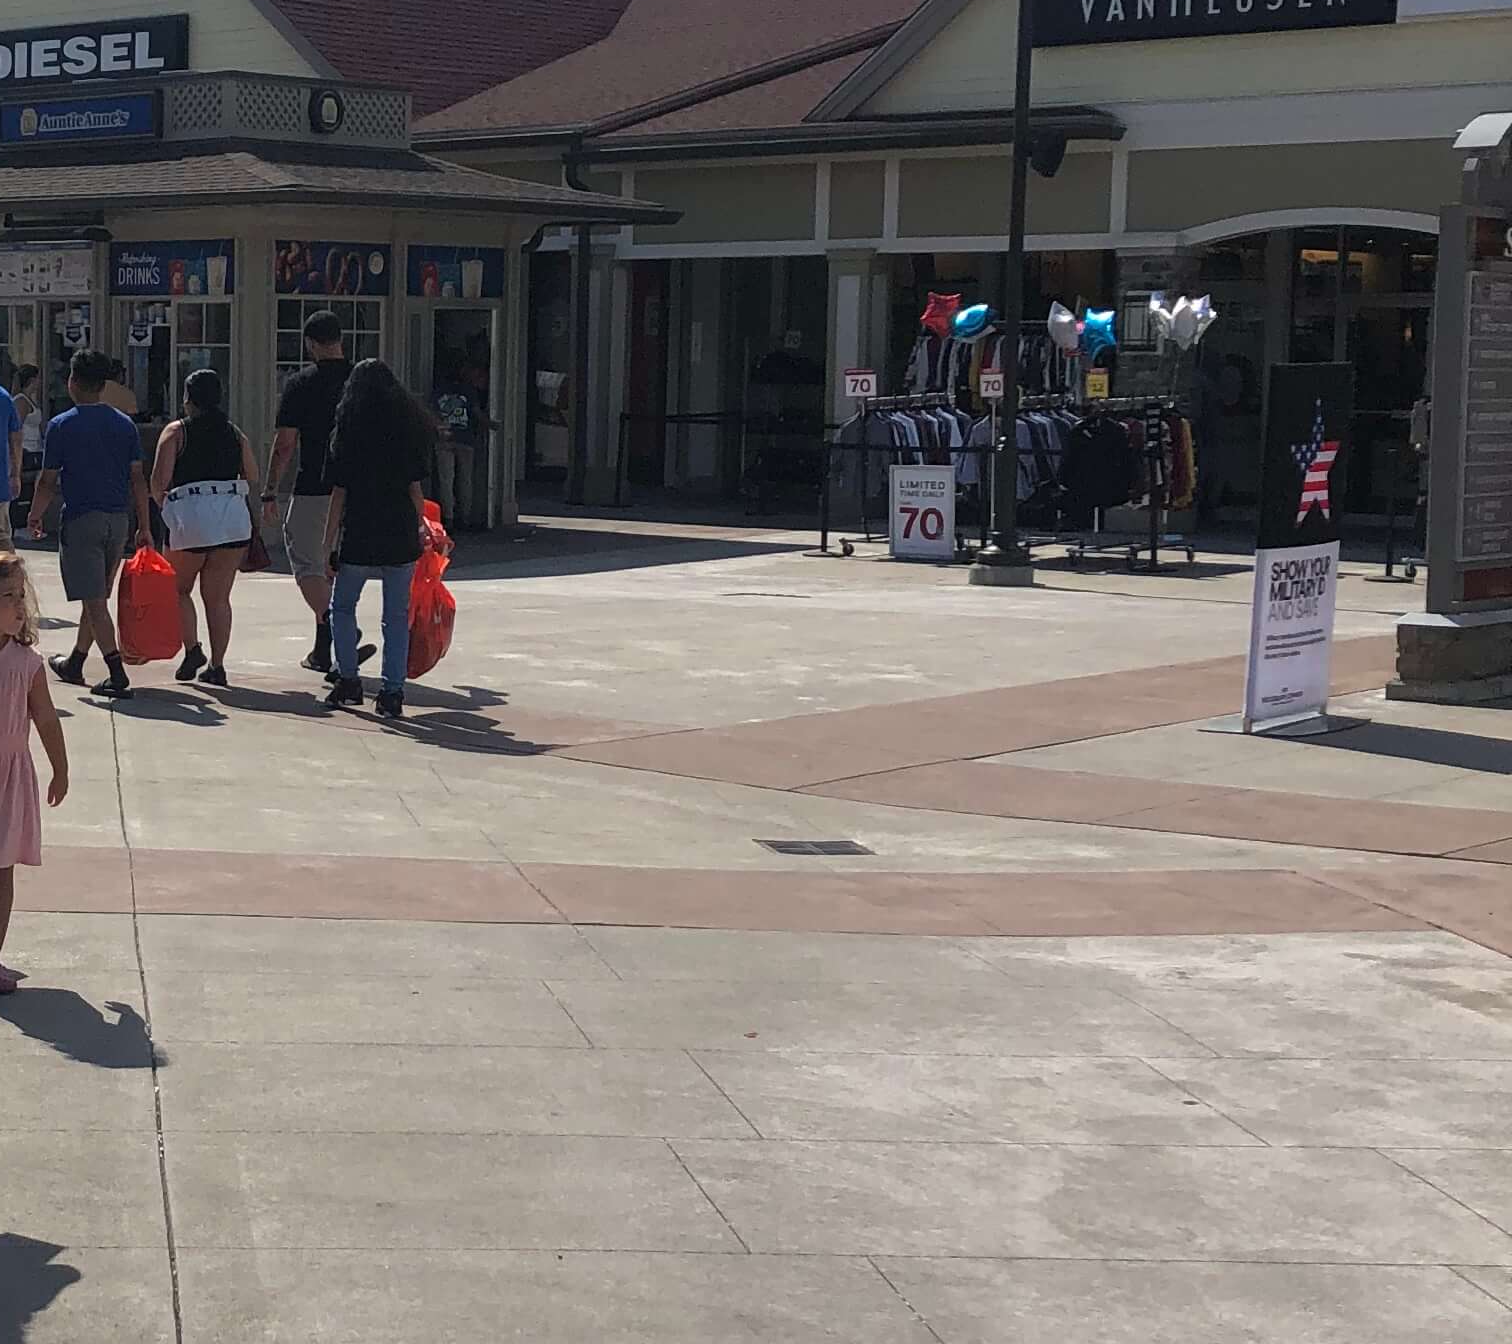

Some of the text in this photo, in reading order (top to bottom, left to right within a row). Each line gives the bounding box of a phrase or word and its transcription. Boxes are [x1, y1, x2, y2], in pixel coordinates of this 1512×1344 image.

[118, 267, 161, 285] DRINKS
[849, 378, 871, 393] 70
[983, 379, 1001, 392] 70
[899, 480, 945, 490] LIMITED
[899, 506, 944, 541] 70
[1271, 559, 1307, 582] SHOW
